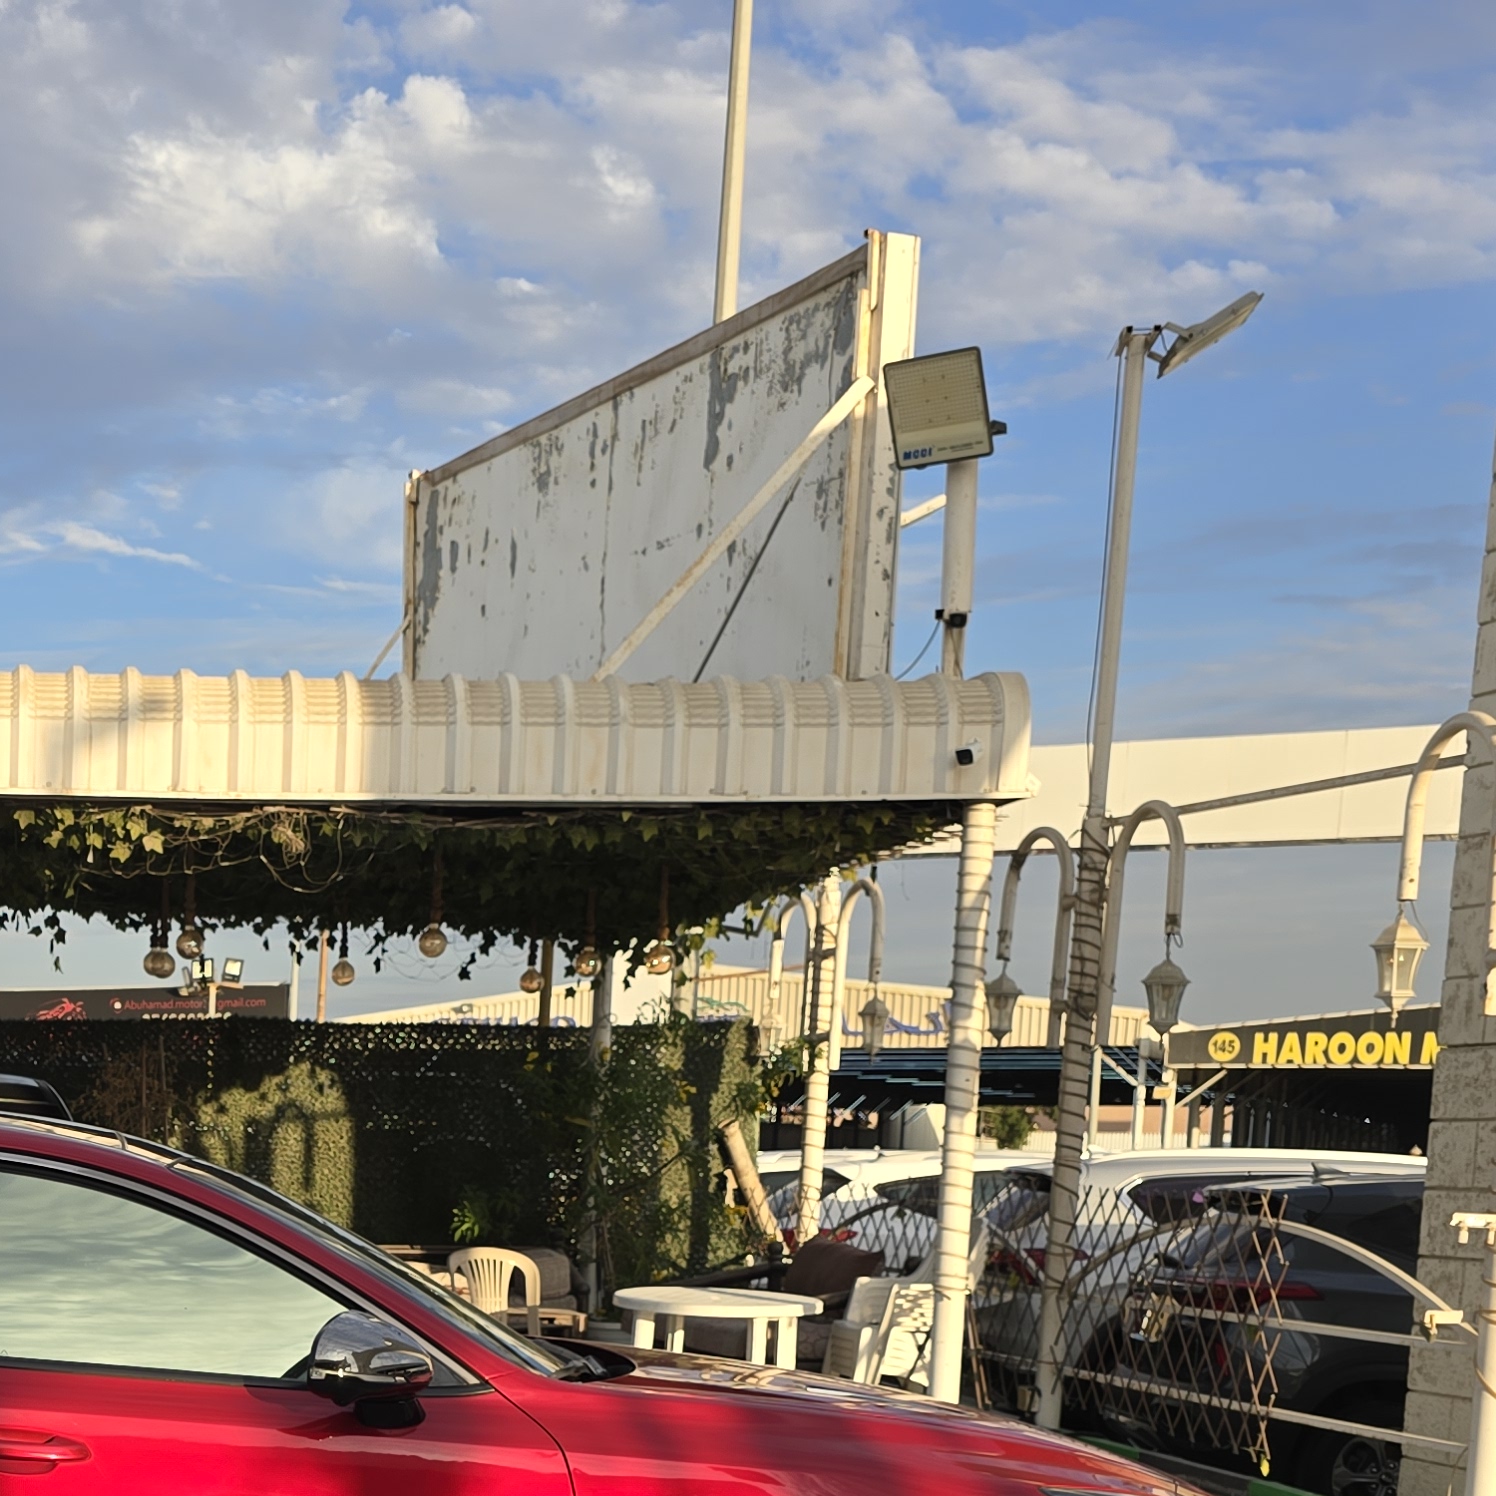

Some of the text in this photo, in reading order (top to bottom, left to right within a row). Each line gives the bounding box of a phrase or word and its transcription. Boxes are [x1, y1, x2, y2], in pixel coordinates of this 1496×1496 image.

[124, 997, 267, 1011] Abuhamad.motorgmail.com
[1212, 1039, 1236, 1055] 145
[1253, 1031, 1412, 1065] HAROON
